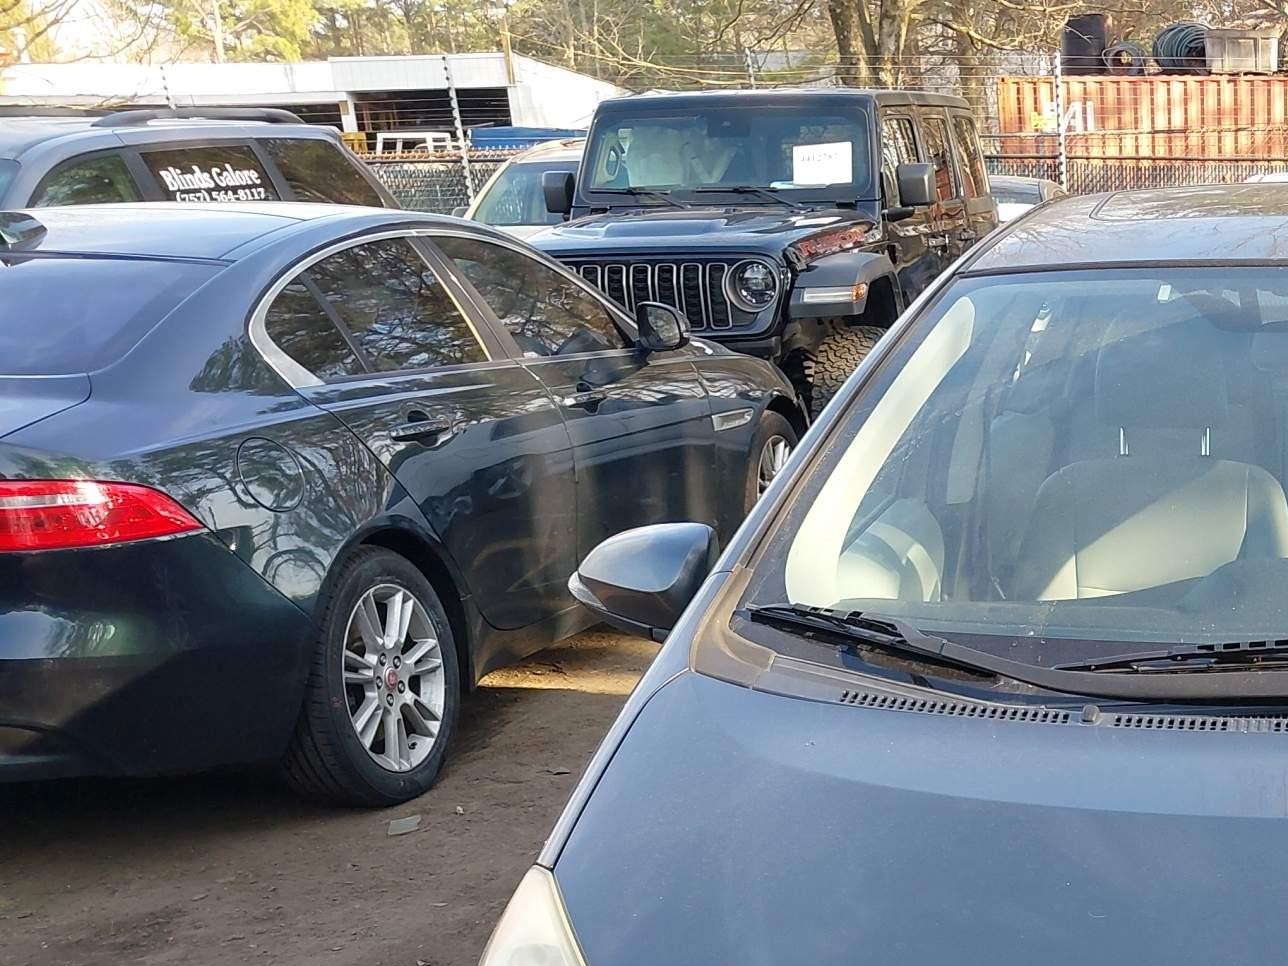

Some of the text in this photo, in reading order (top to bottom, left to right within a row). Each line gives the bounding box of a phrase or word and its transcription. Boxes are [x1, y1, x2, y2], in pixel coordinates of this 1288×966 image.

[159, 163, 261, 191] Blinds Galore
[212, 188, 265, 202] 564-8117
